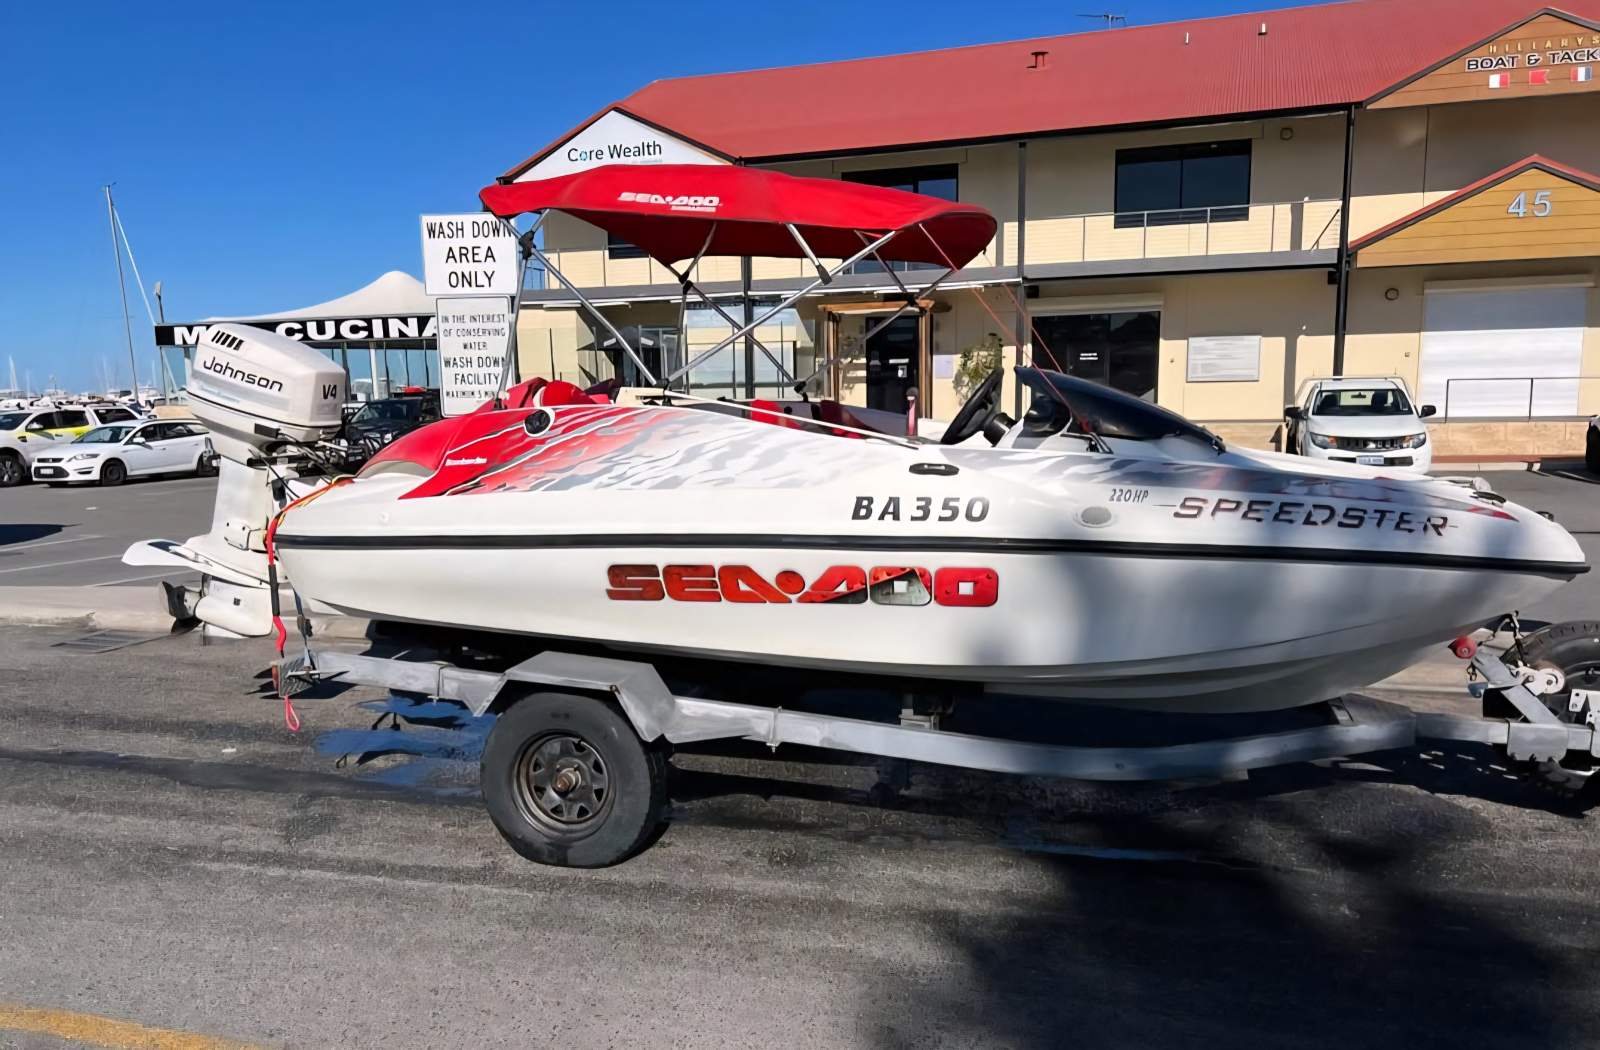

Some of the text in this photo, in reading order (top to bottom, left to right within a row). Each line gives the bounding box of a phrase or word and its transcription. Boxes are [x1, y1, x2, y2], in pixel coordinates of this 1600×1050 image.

[1466, 55, 1519, 71] BOAT
[1526, 54, 1542, 66] &
[567, 140, 662, 162] Core Wealth
[1507, 191, 1552, 218] 45
[426, 221, 465, 239] WASH
[445, 246, 496, 264] AREA
[448, 270, 496, 288] ONLY
[441, 313, 506, 324] IN THE INTEREST
[442, 328, 506, 338] OF CONSERVING
[462, 341, 488, 350] WATER
[443, 356, 473, 369] WASH
[203, 356, 283, 393] Johnson
[454, 373, 500, 386] FACILITY
[322, 384, 338, 400] V4
[851, 495, 991, 523] BA350
[1173, 496, 1449, 537] SPEEDSTER
